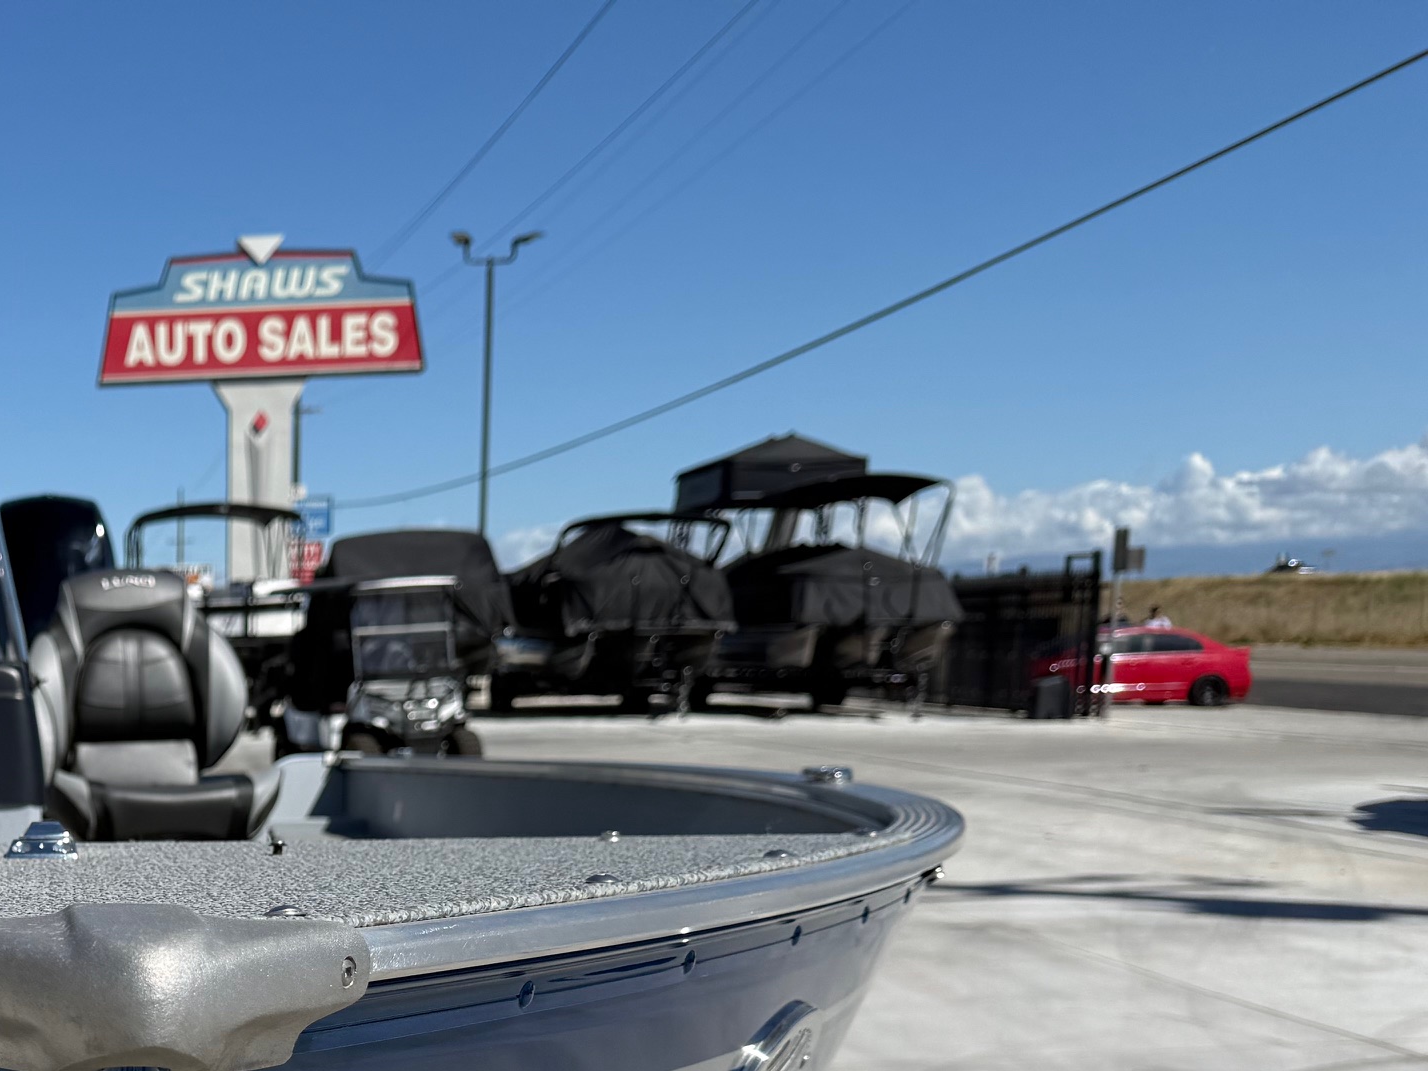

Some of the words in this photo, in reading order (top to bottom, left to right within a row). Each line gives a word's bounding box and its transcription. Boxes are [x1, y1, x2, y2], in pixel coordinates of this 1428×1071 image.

[173, 264, 351, 303] SHAWS
[124, 316, 247, 367] AUTO
[257, 310, 399, 363] SALES
